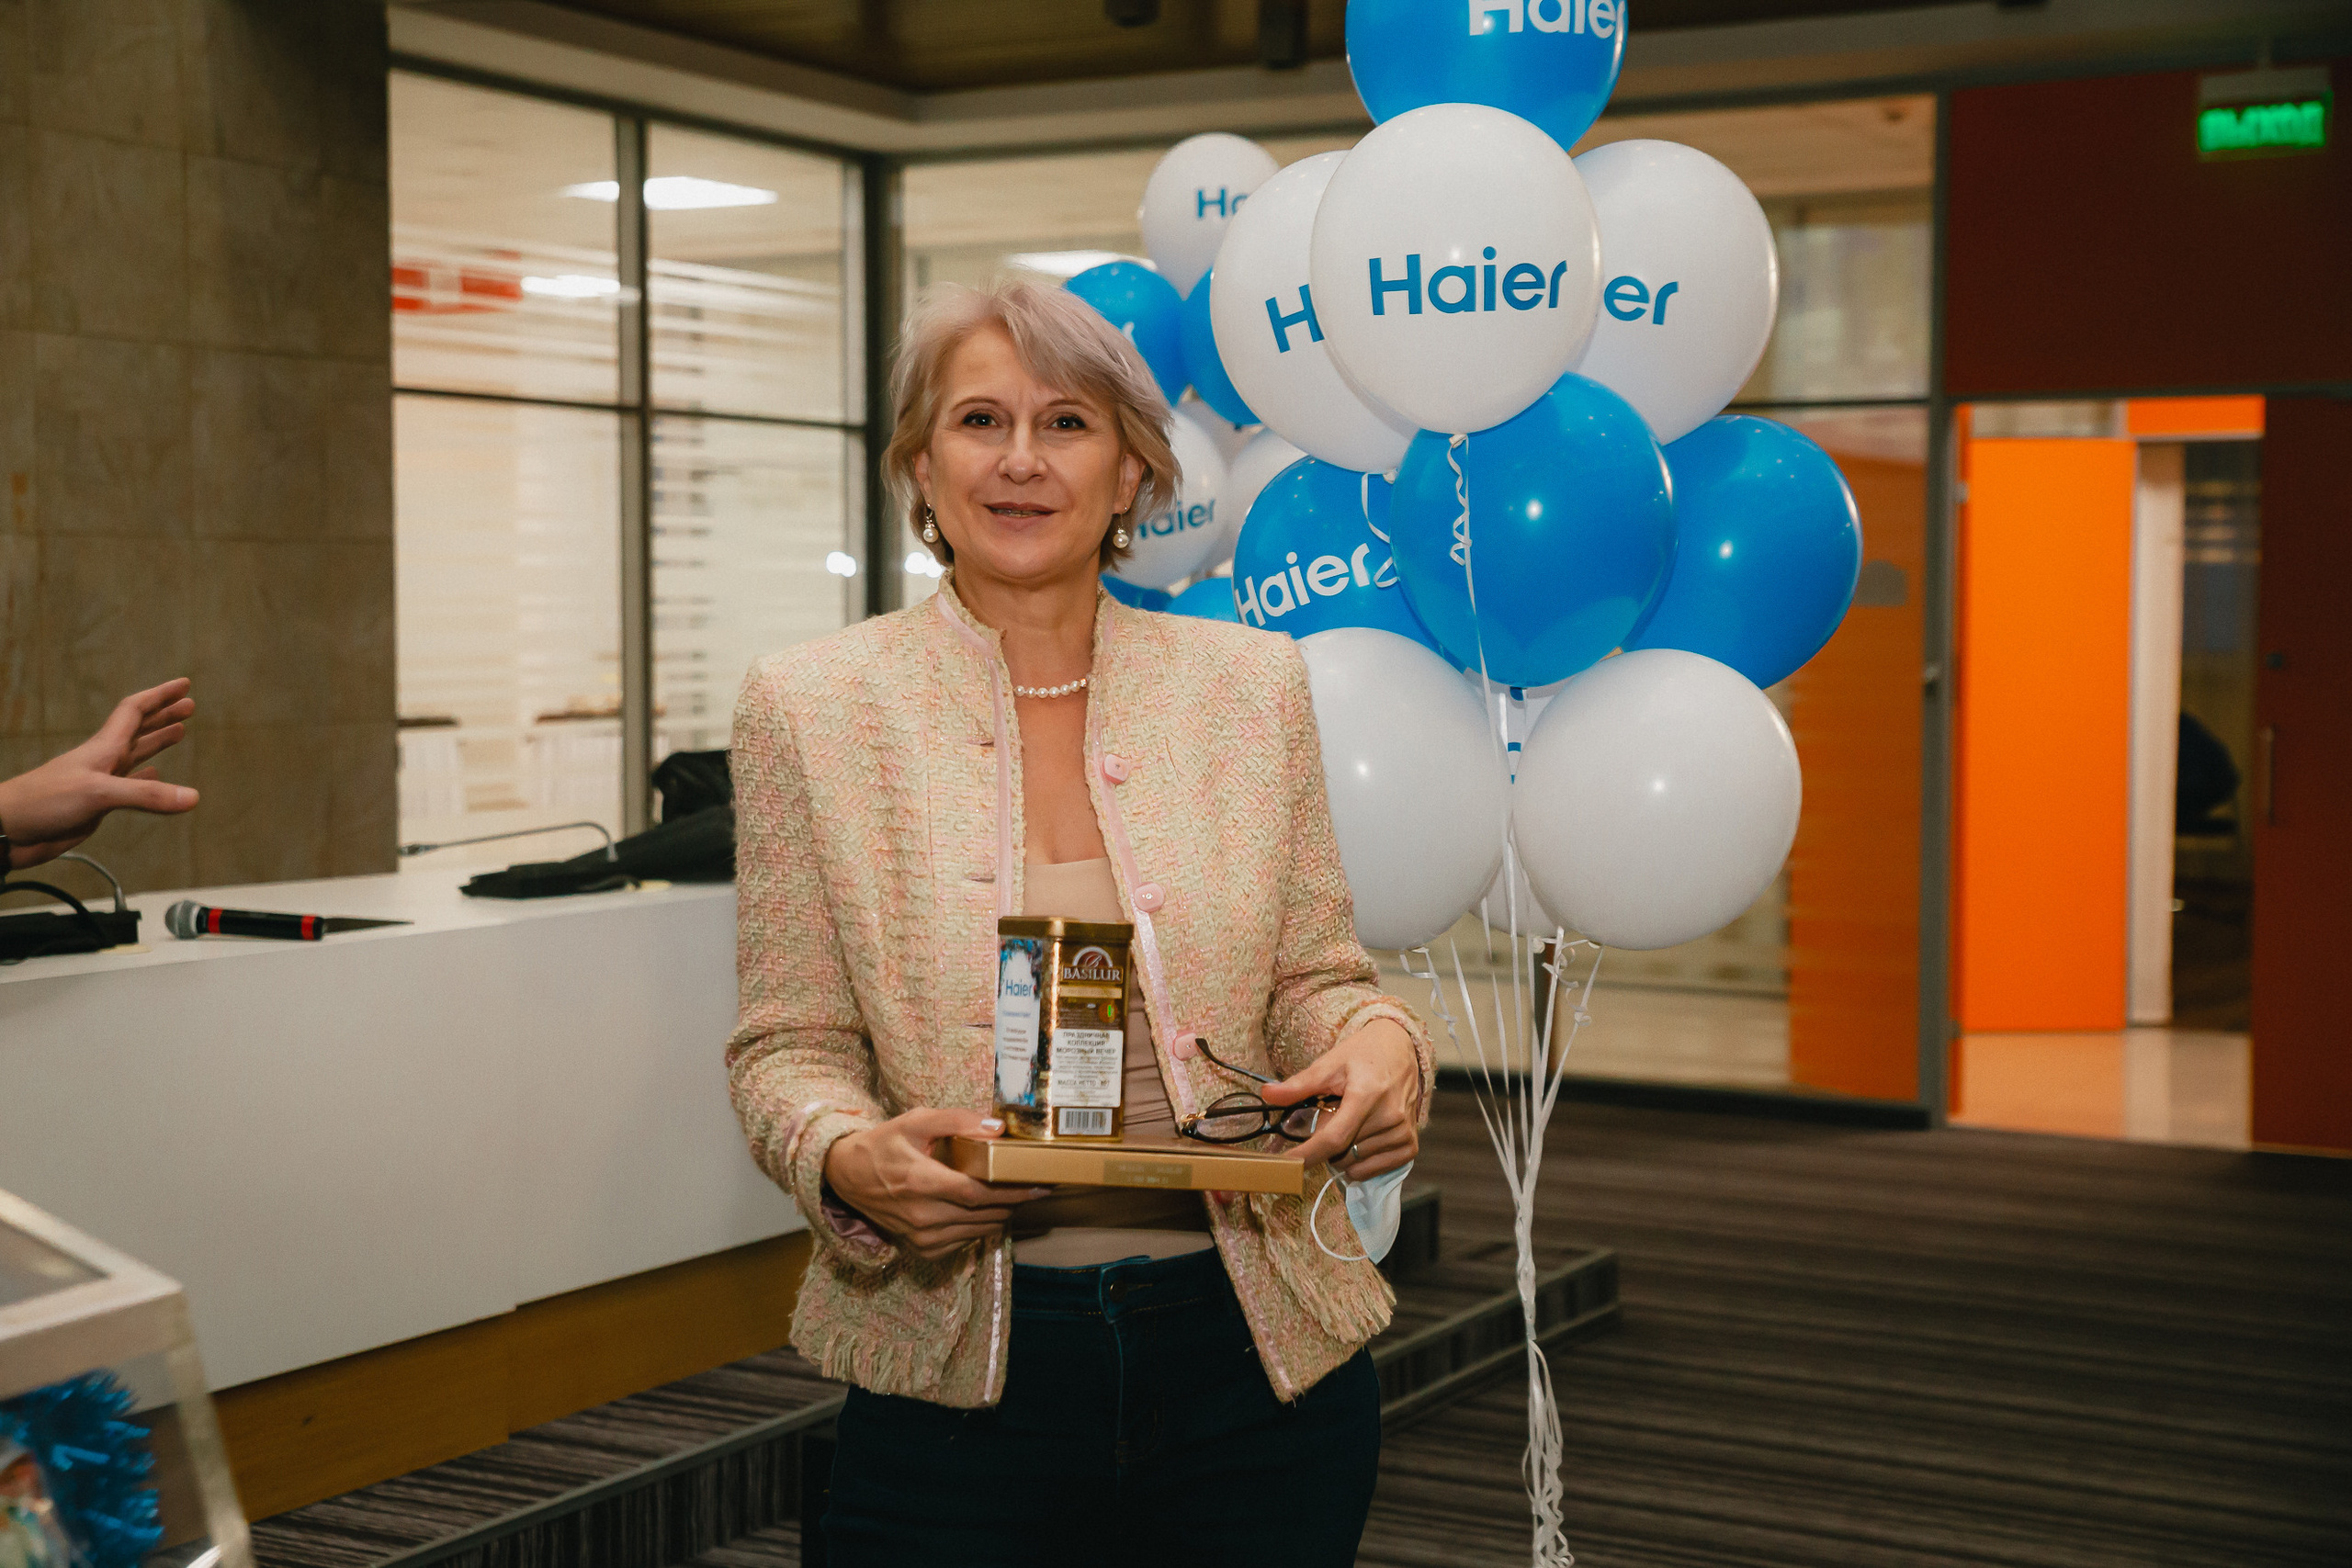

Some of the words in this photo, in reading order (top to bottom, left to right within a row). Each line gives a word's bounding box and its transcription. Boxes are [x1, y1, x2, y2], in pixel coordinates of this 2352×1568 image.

[1368, 245, 1567, 316] Haier
[1235, 543, 1370, 627] Haier
[1006, 978, 1033, 997] Haier
[1064, 967, 1120, 981] BASILUR
